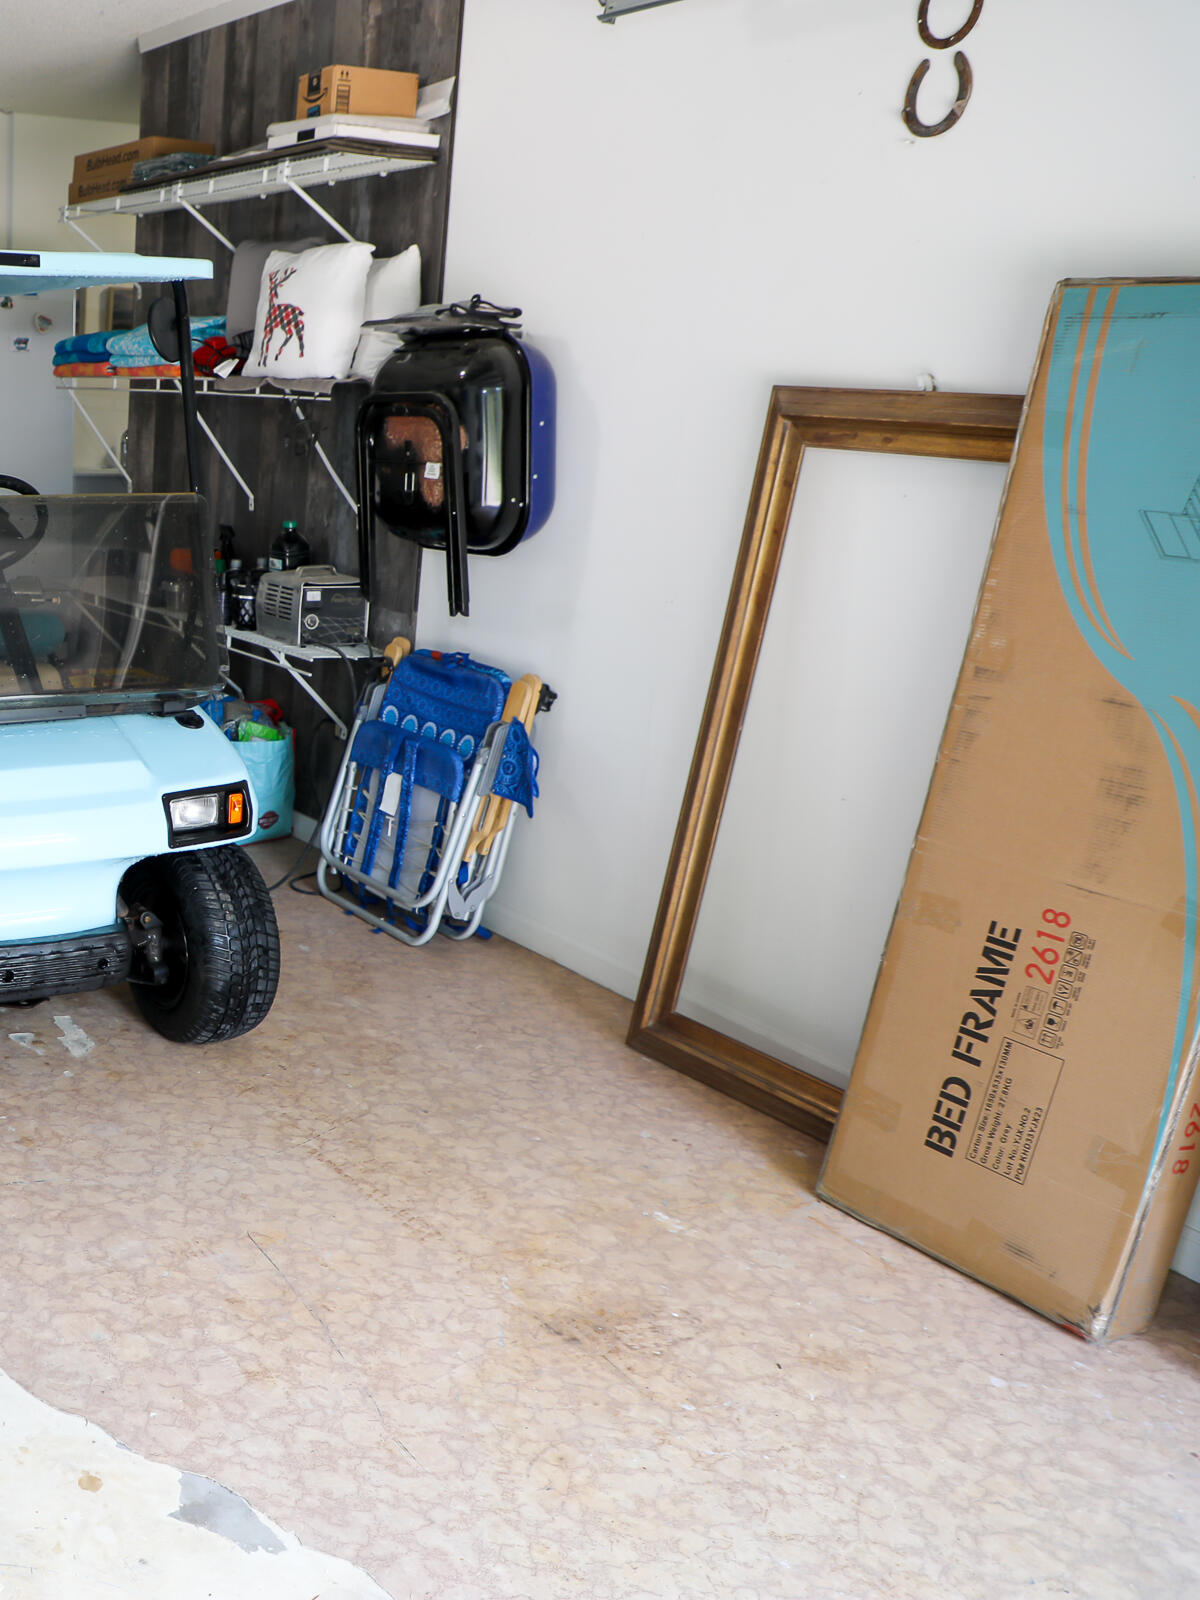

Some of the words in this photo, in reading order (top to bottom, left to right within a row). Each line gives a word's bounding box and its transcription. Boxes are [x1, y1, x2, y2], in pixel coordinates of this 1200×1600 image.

[1025, 908, 1071, 985] 2618
[923, 1076, 972, 1158] BED
[951, 920, 1022, 1067] FRAME
[969, 1132, 983, 1160] Carton
[1001, 1124, 1013, 1144] Grey
[980, 1138, 993, 1164] Gross
[1004, 1158, 1014, 1176] Lot
